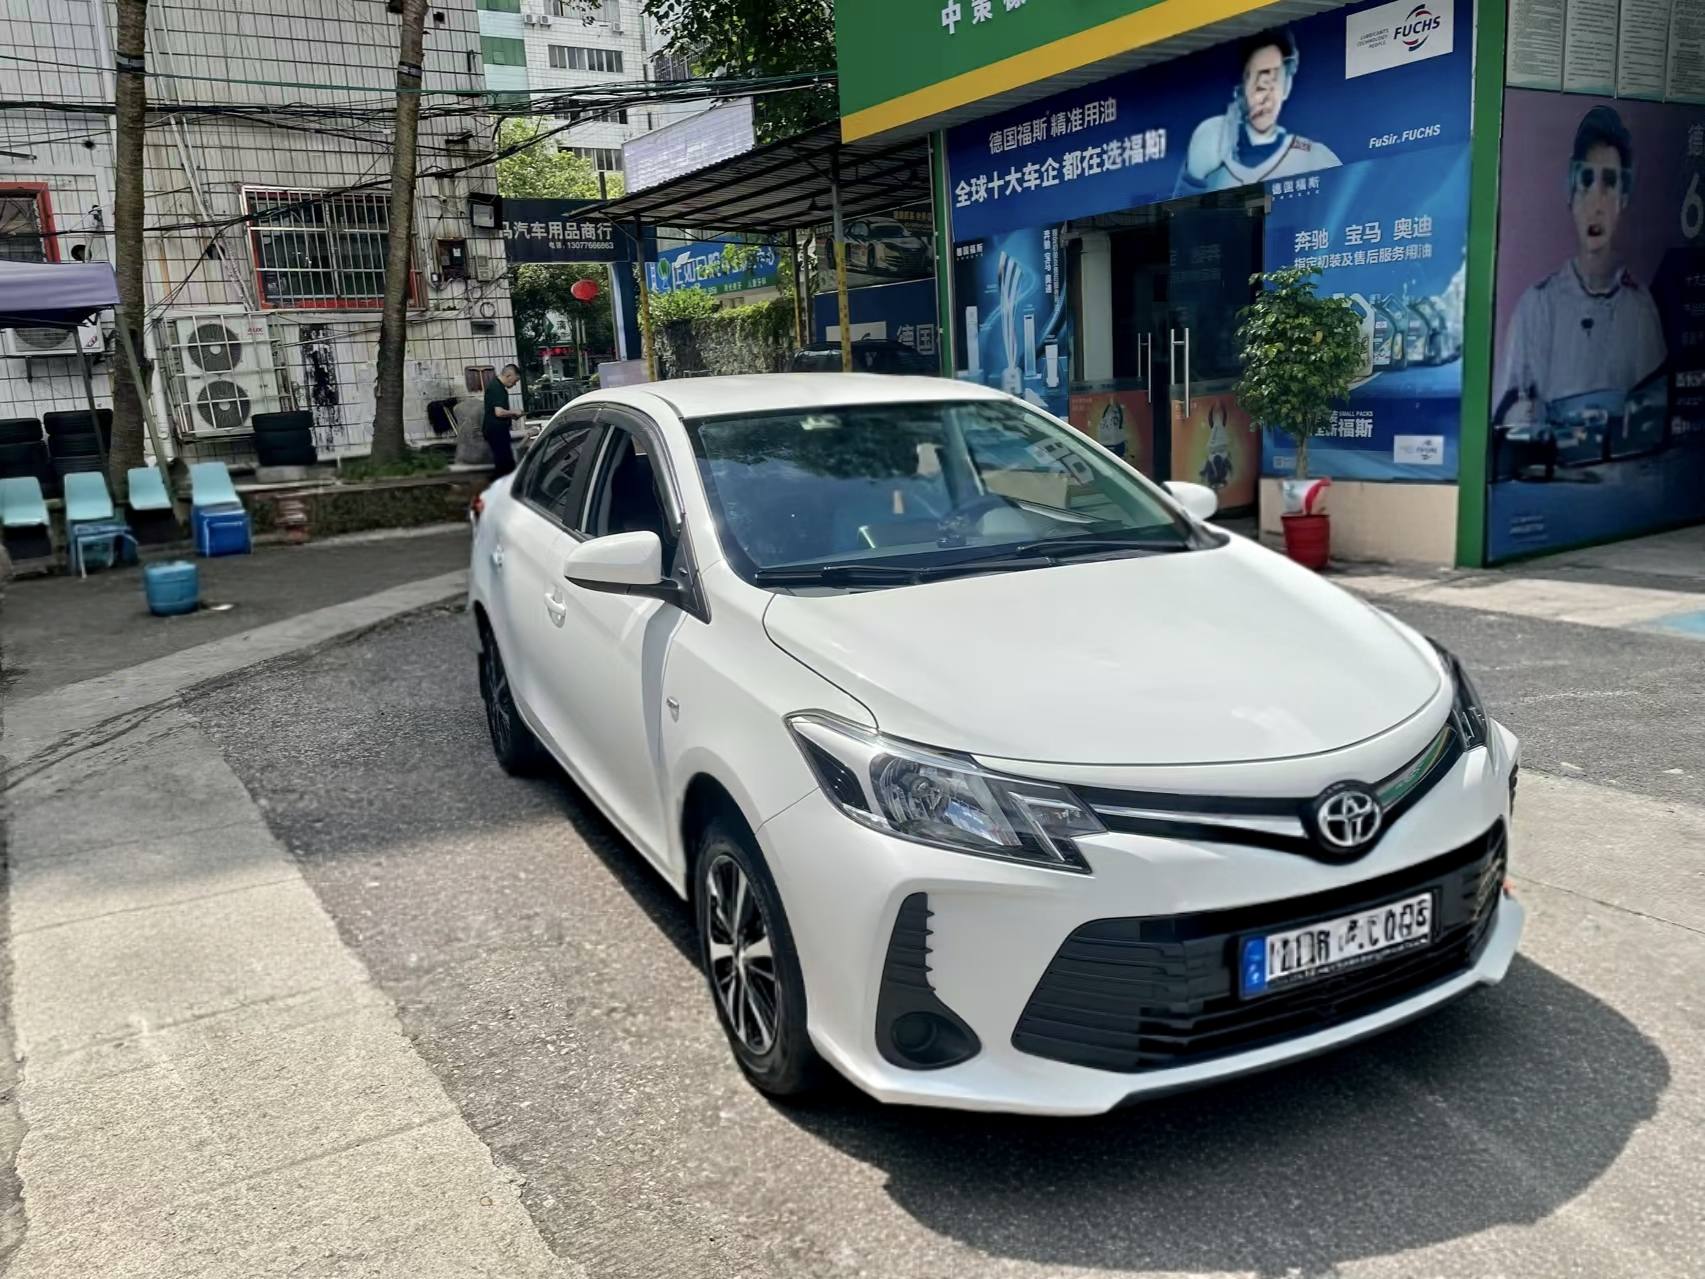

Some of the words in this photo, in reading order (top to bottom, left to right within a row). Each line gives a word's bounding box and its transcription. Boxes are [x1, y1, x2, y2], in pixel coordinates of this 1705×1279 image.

[1393, 15, 1441, 40] FUCHS
[988, 116, 1048, 154] 德国福斯
[1050, 97, 1118, 137] 精准用油
[1402, 124, 1441, 143] FUCHS
[954, 157, 1060, 208] 全球十大车企
[1294, 228, 1329, 253] 奔驰
[1345, 221, 1382, 246] 宝马
[1393, 214, 1433, 241] 奥迪
[896, 324, 937, 355] 德国
